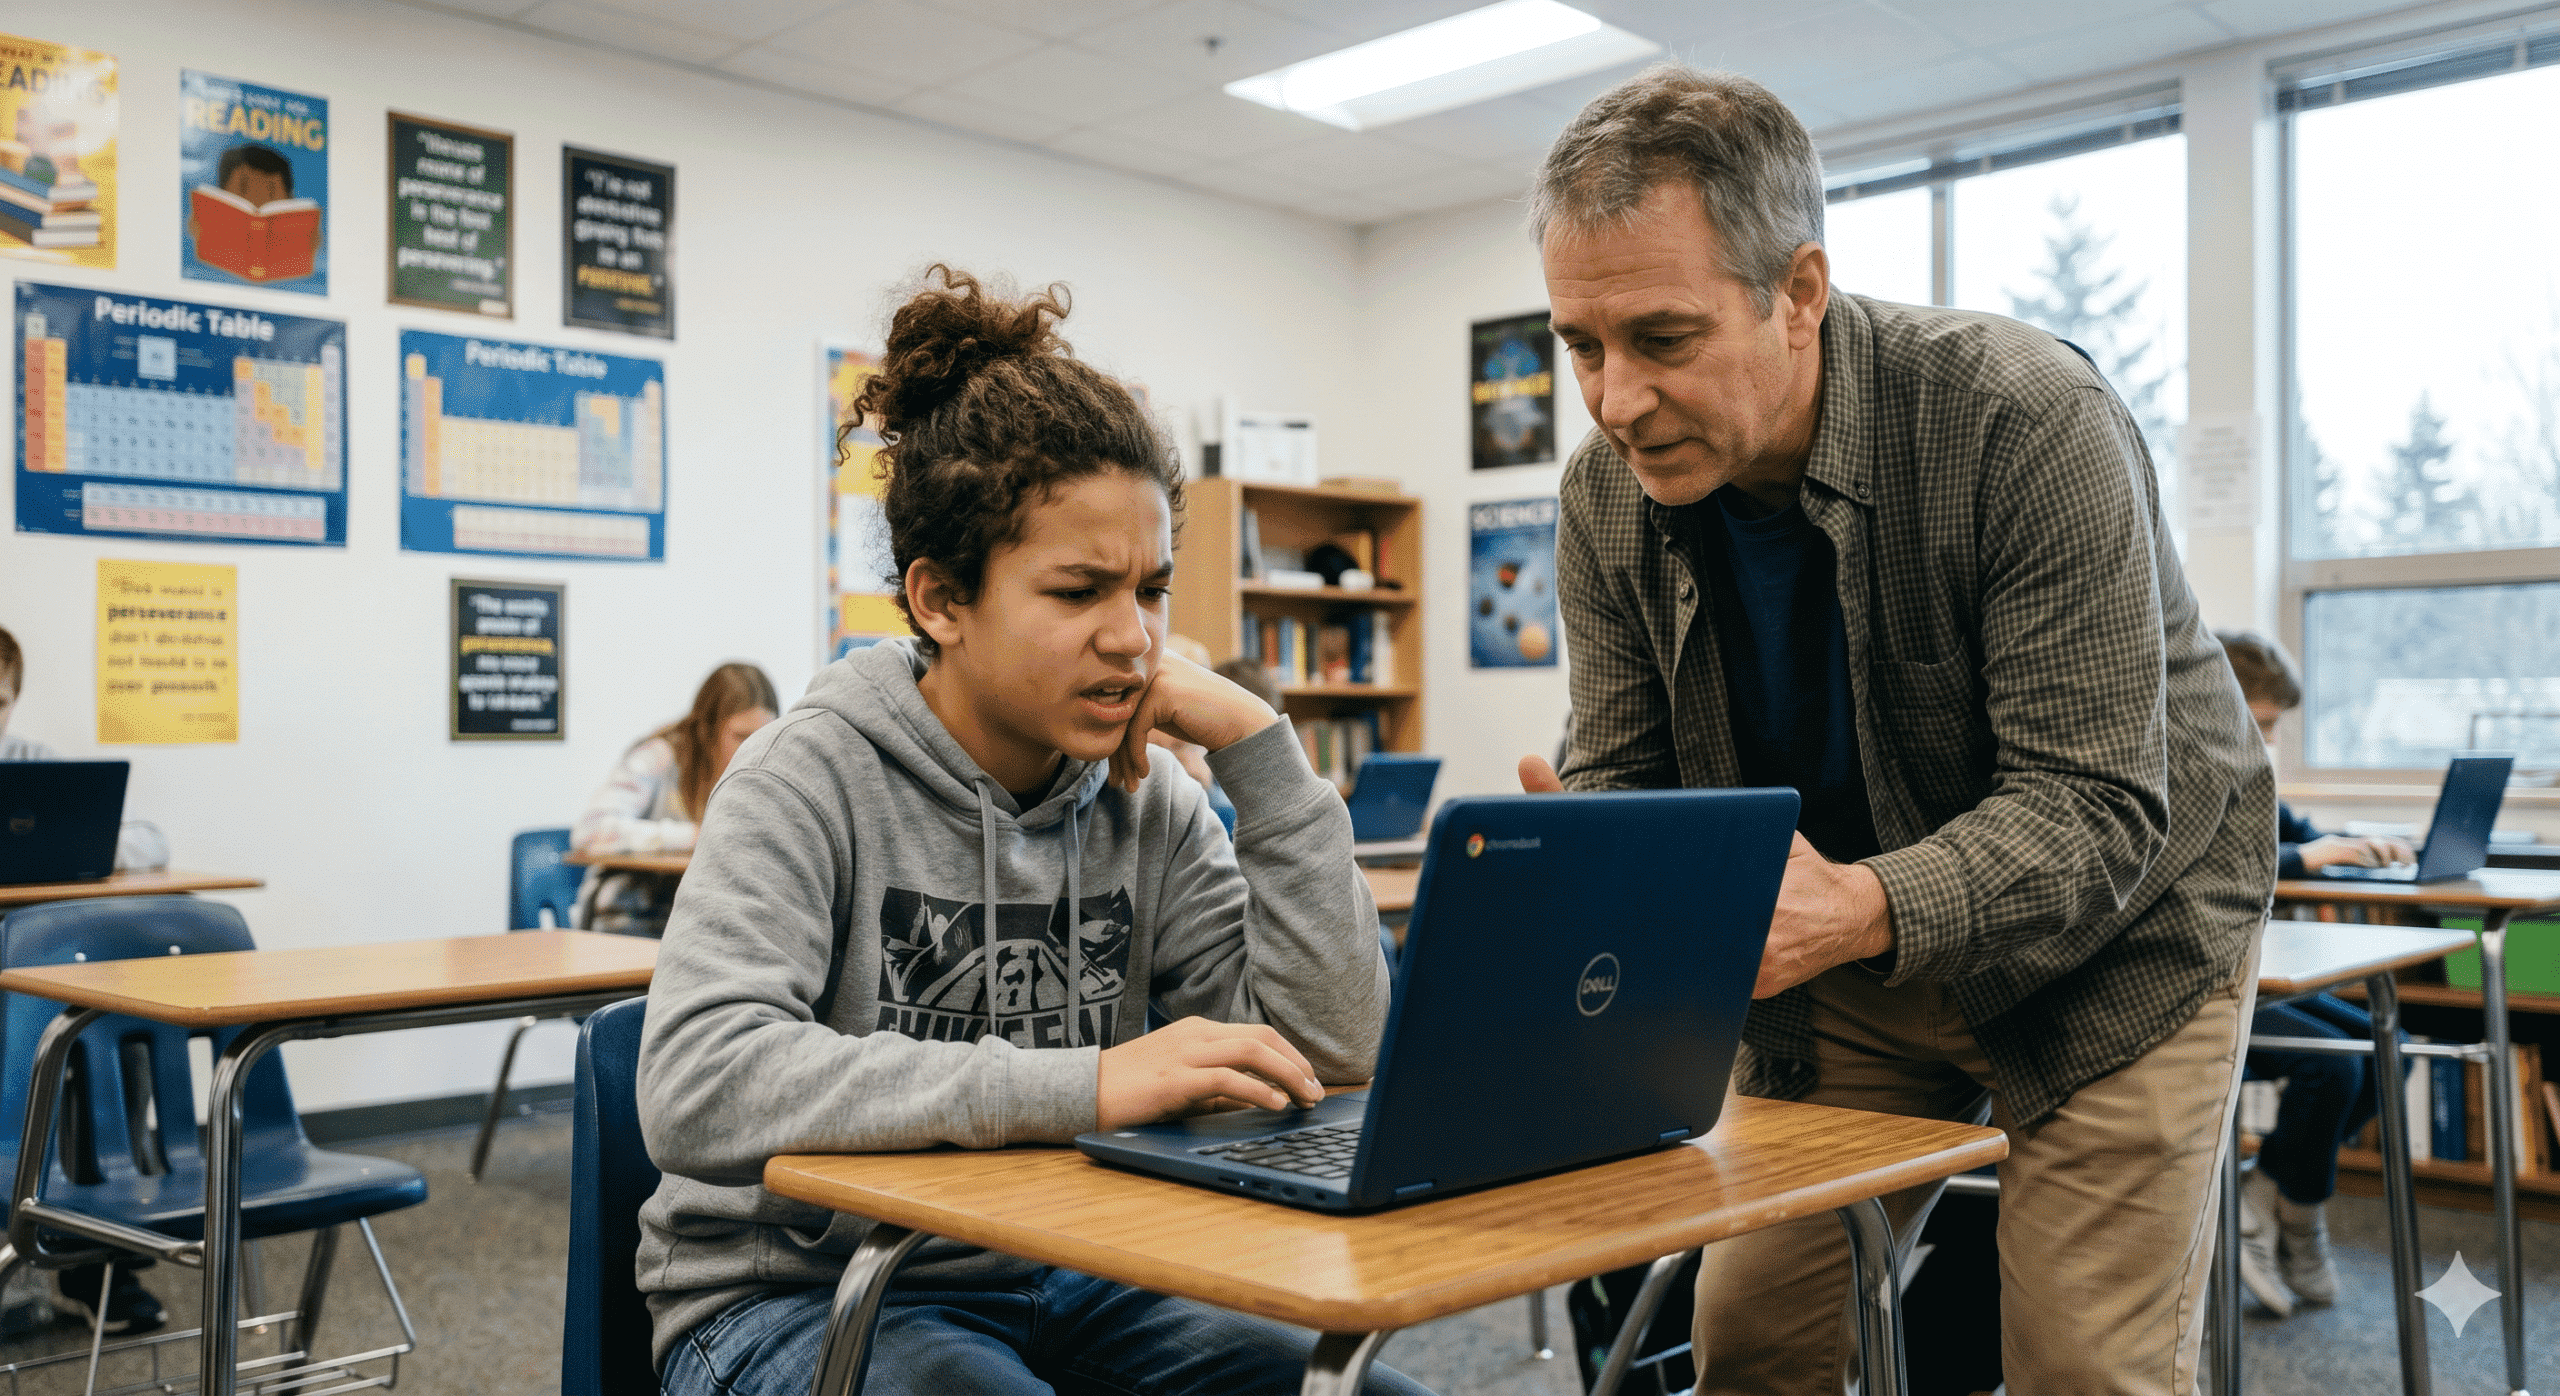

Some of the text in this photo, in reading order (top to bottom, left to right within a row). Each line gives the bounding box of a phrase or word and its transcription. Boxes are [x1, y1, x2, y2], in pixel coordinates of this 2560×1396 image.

[185, 96, 324, 151] READING
[95, 296, 275, 341] Periodic Table
[465, 338, 550, 373] Periodic
[1582, 976, 1613, 994] DELL
